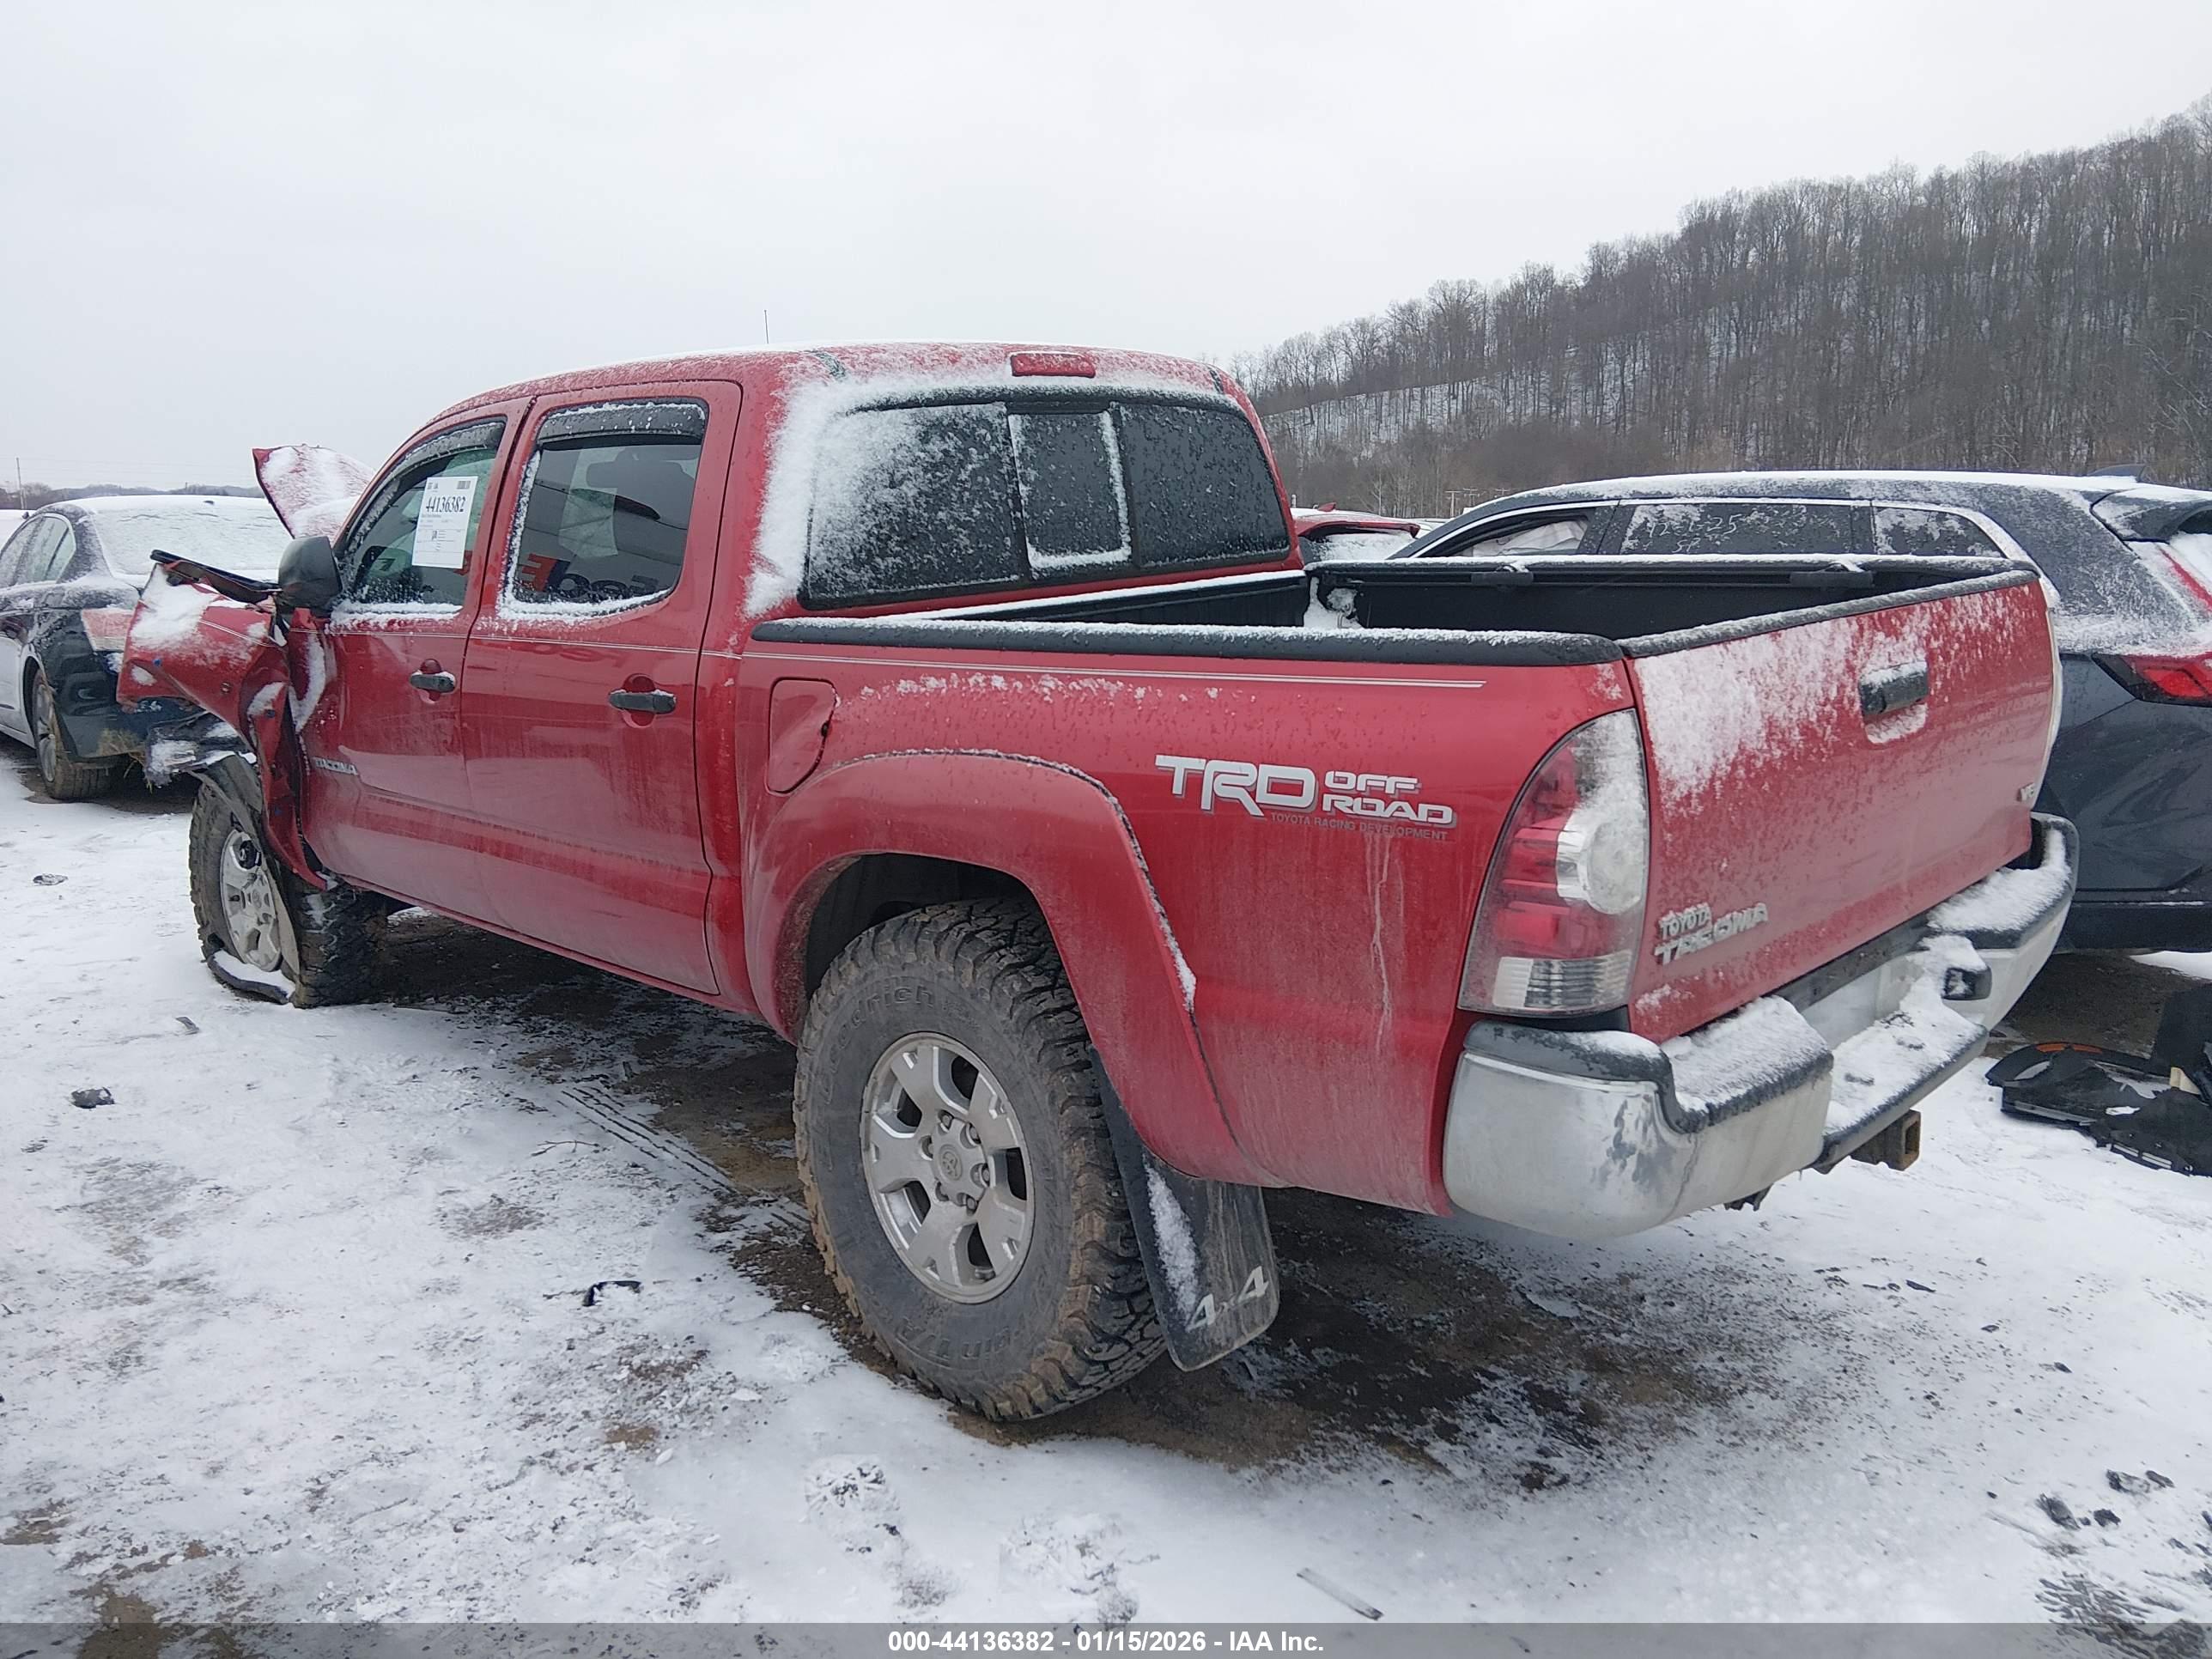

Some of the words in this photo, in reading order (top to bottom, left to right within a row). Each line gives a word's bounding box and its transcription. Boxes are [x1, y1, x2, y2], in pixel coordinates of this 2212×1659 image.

[426, 495, 465, 513] 44136382
[1154, 754, 1318, 818] TRD
[1323, 769, 1419, 795] OFF
[1271, 812, 1310, 826] TOYOTA
[1314, 817, 1357, 831] RACING
[1359, 823, 1449, 841] DEVELOPMENT
[1322, 793, 1456, 828] ROAD
[1654, 902, 1770, 966] TACOMA
[1658, 902, 1712, 940] TOYOTA
